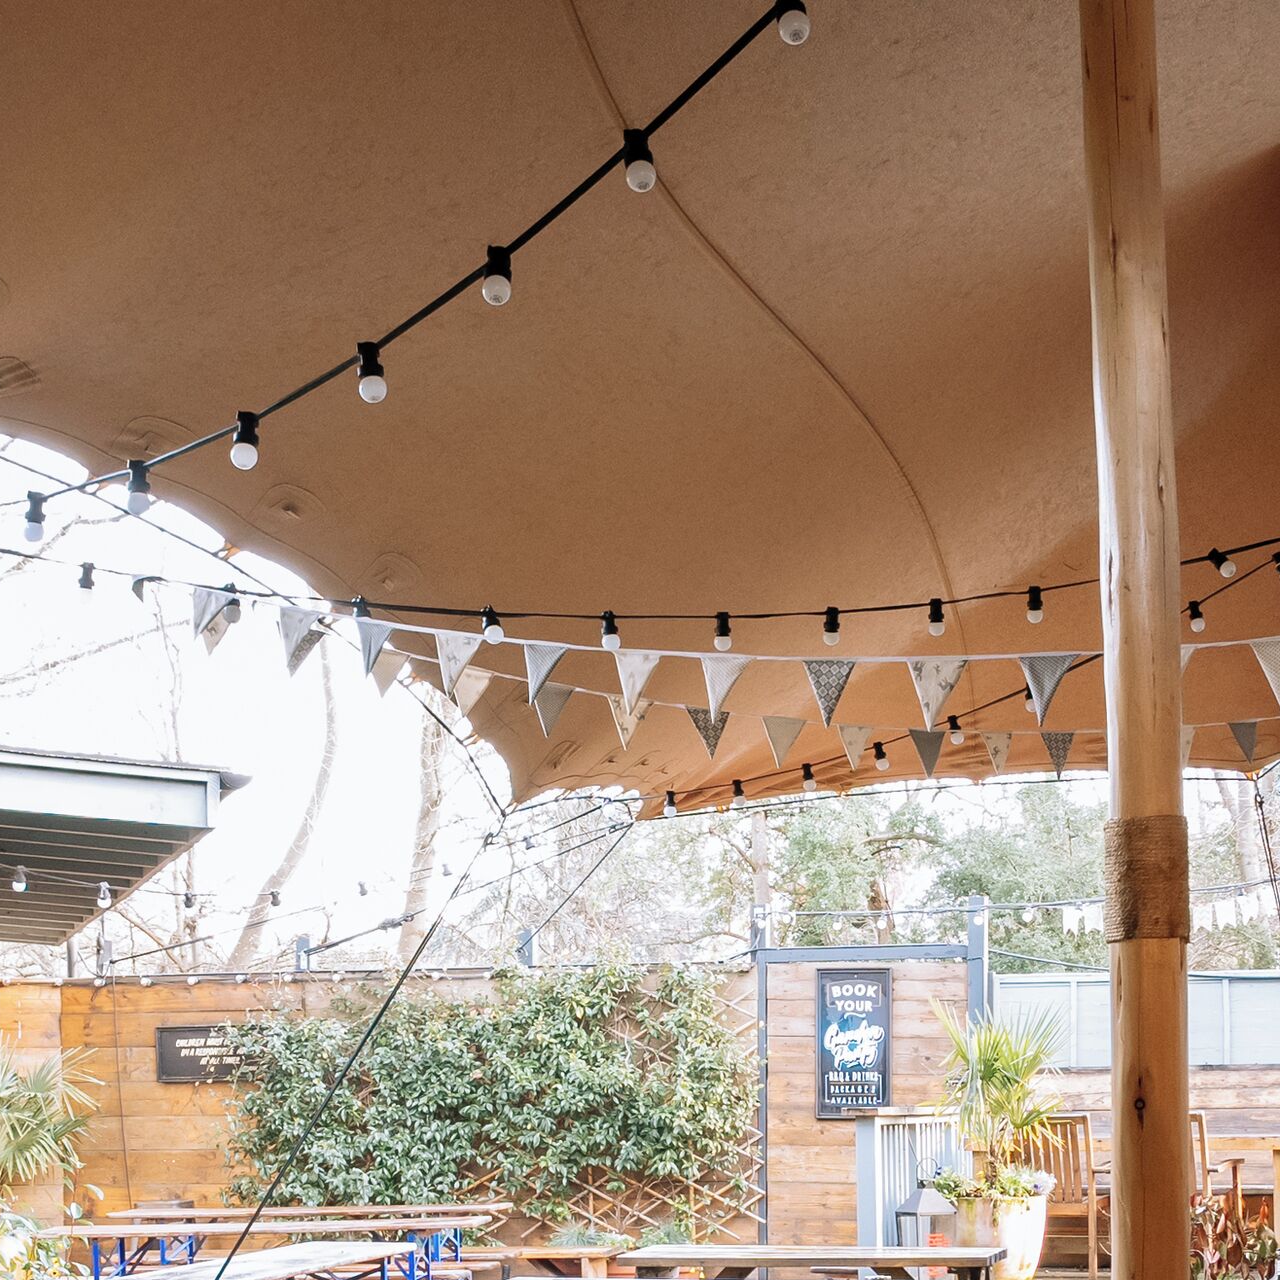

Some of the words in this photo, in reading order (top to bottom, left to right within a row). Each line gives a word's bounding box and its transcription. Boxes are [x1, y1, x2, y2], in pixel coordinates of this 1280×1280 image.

[831, 984, 878, 998] BOOK
[835, 999, 873, 1012] YOUR
[175, 1038, 205, 1047] CHILDREN
[828, 1071, 844, 1082] BBQ
[845, 1071, 851, 1081] &
[852, 1071, 879, 1082] DRINKS
[830, 1085, 876, 1093] PACKAGES
[830, 1096, 877, 1105] AVAILABLE
